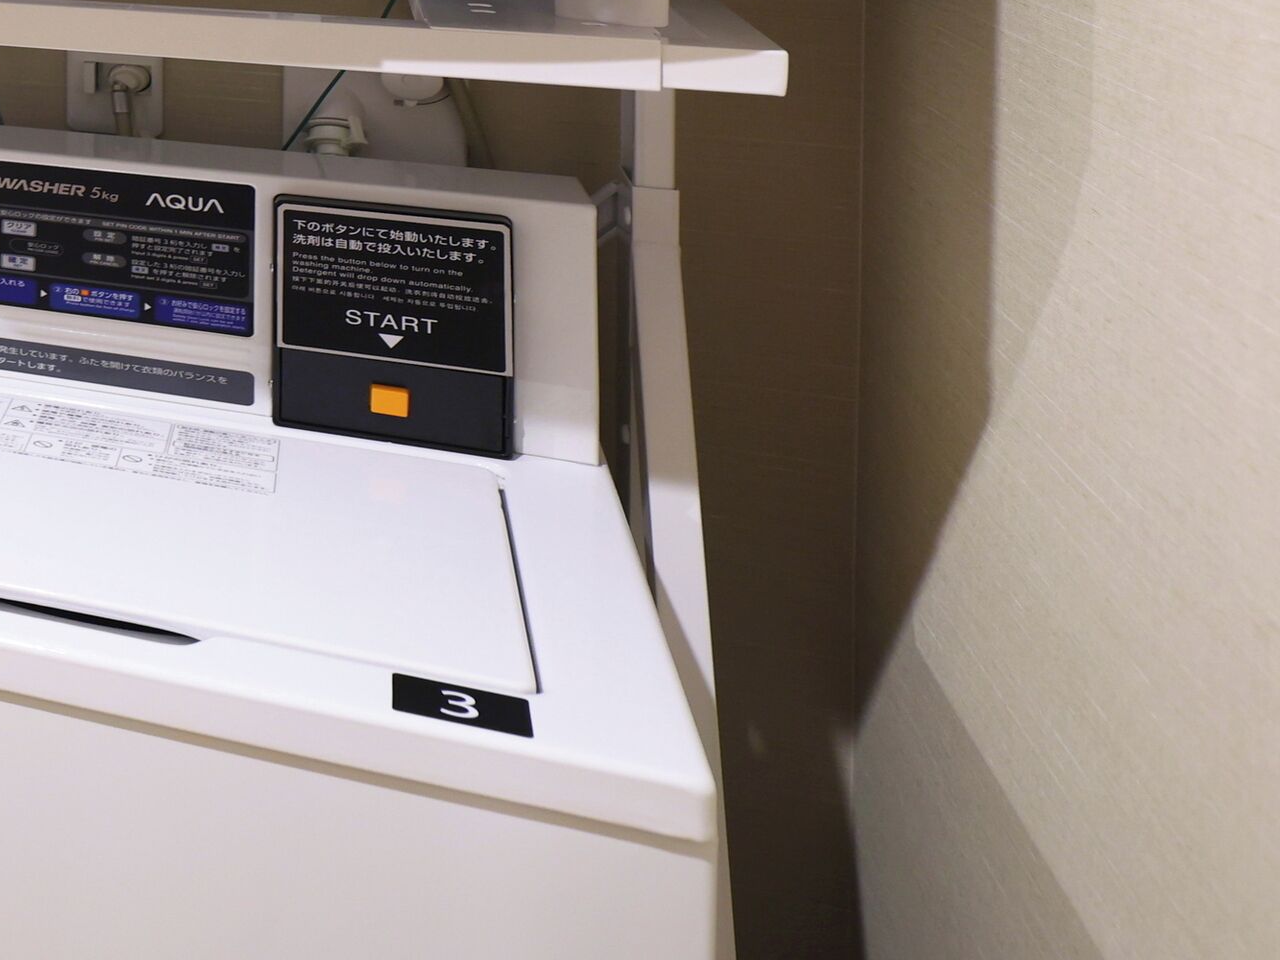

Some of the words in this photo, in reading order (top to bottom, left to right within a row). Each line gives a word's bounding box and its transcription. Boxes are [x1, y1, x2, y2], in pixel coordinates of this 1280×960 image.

[90, 186, 119, 203] 5kg
[145, 192, 224, 213] AQUA
[293, 219, 497, 251] 下のボタンにて始動いたします。
[292, 233, 485, 264] 洗剤は自動で投入いたします。
[292, 252, 318, 260] Press
[337, 257, 366, 265] button
[369, 260, 397, 269] below
[448, 268, 463, 277] the
[292, 260, 329, 271] washing
[332, 263, 373, 274] machine.
[292, 267, 337, 278] Detergent
[357, 273, 378, 283] drop
[381, 275, 405, 284] down
[408, 278, 473, 294] automatically.
[345, 309, 438, 334] START
[440, 690, 479, 719] 3
